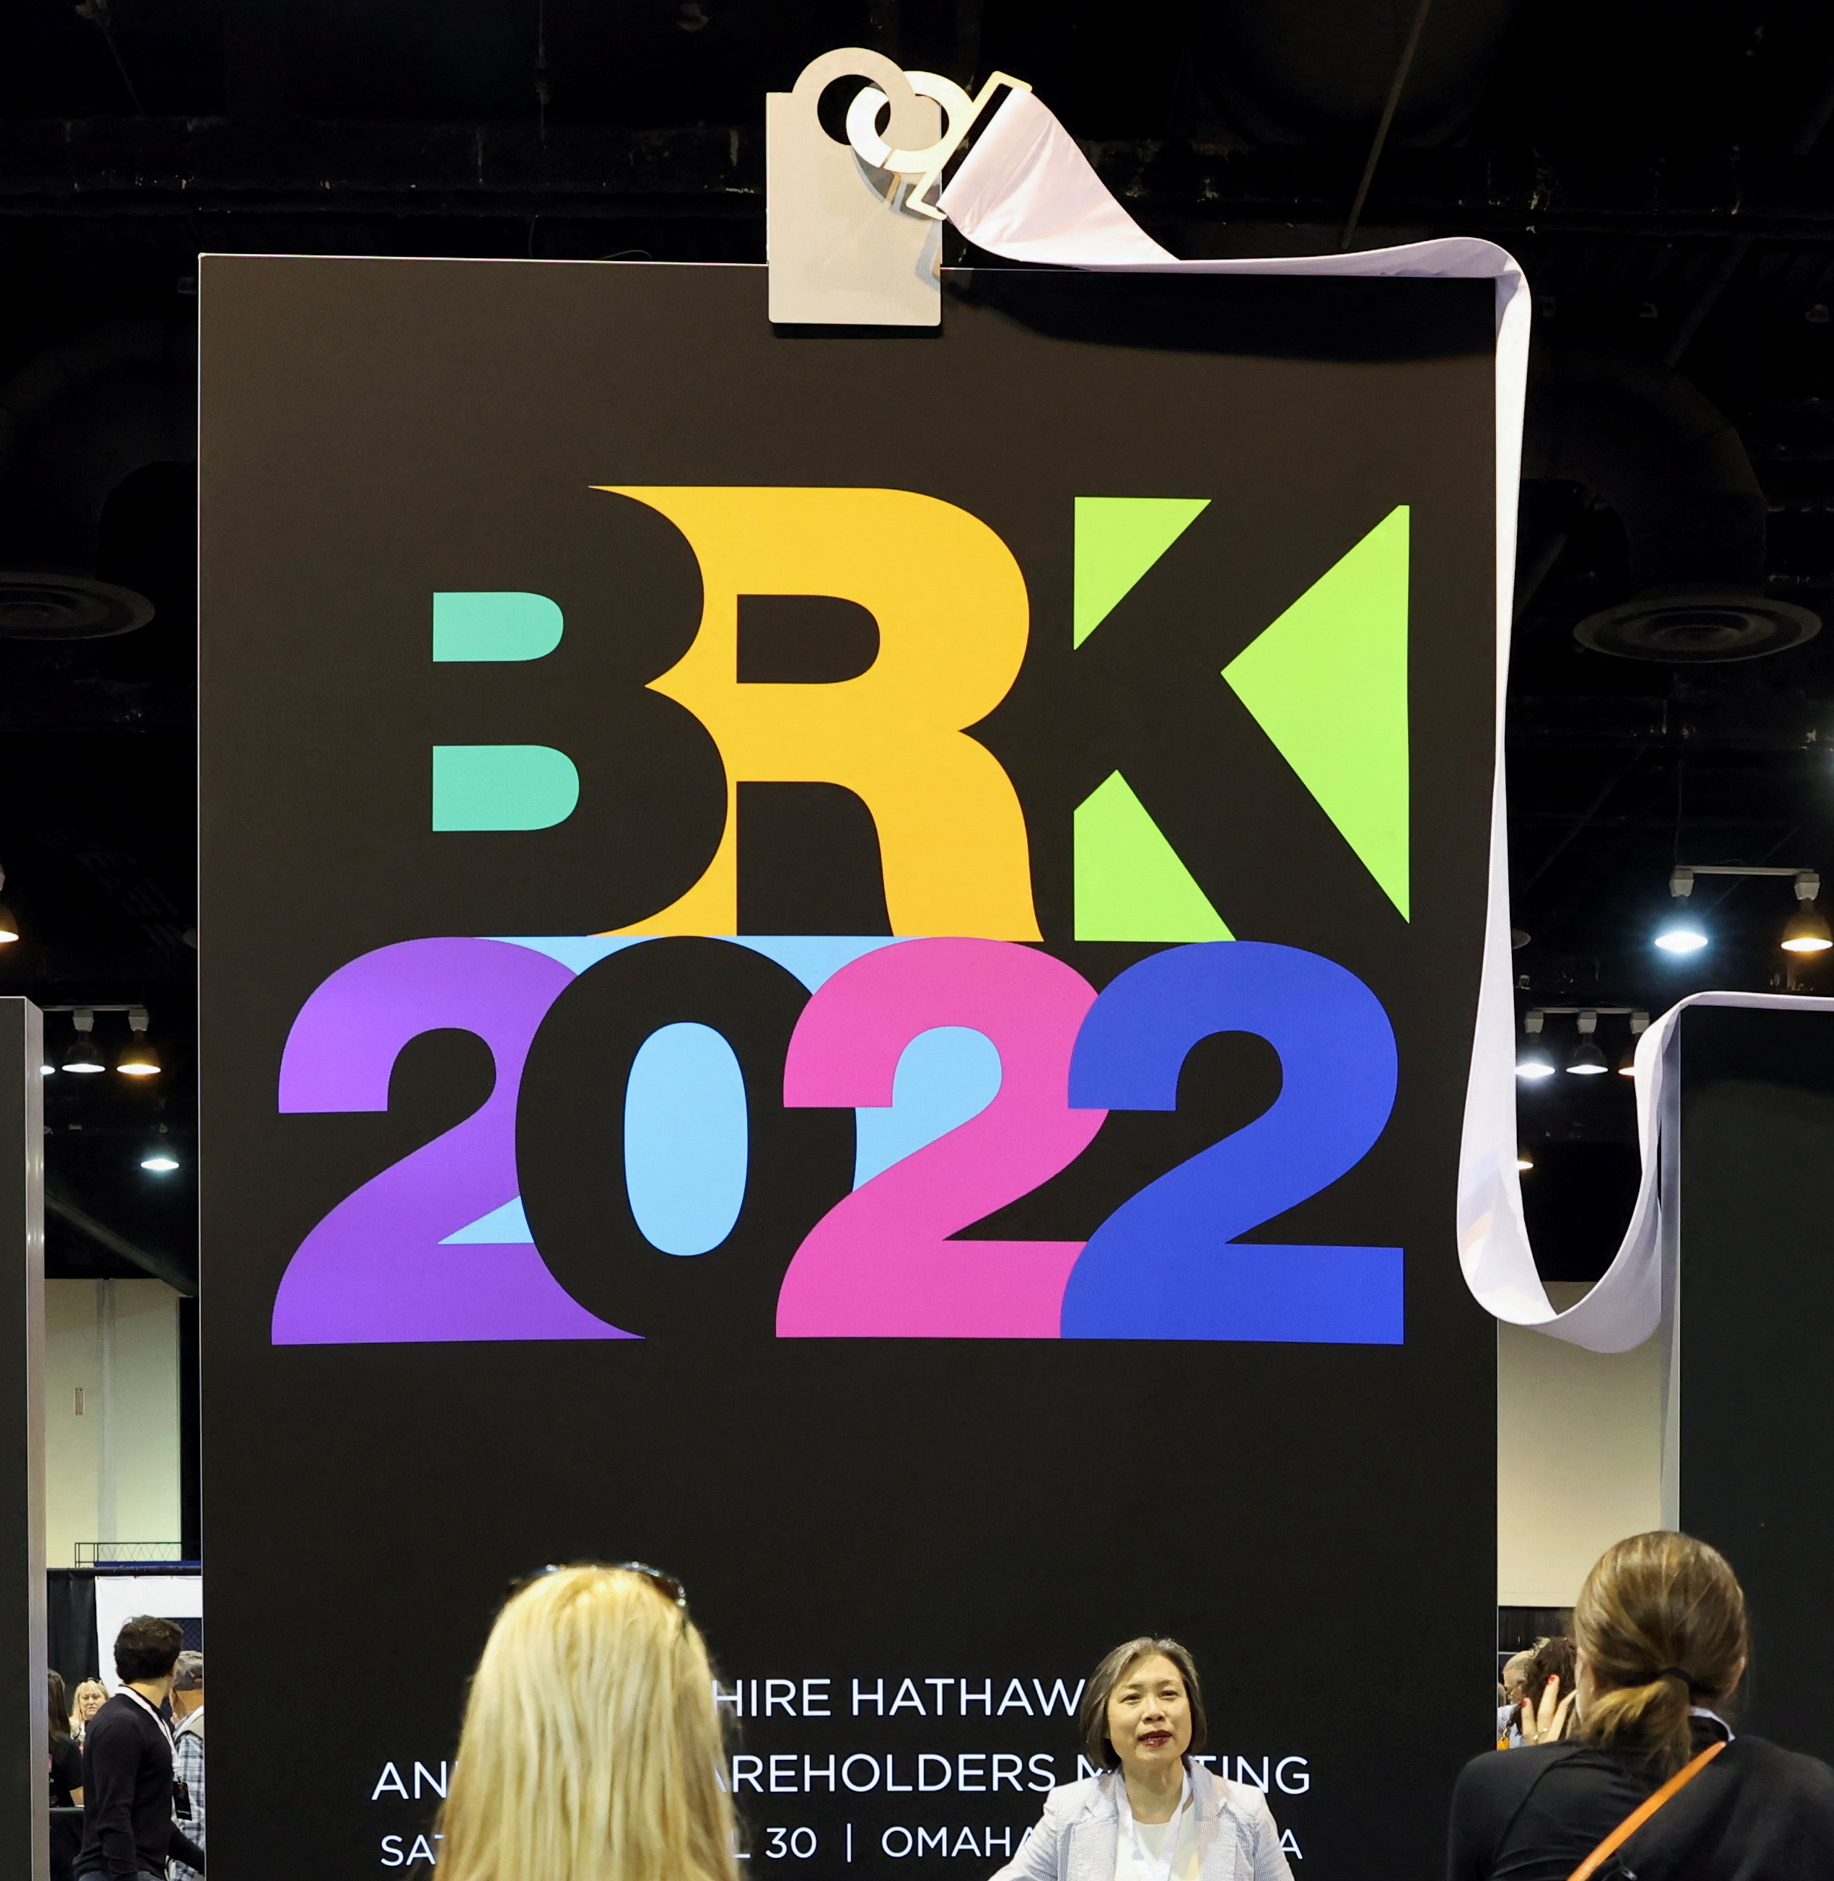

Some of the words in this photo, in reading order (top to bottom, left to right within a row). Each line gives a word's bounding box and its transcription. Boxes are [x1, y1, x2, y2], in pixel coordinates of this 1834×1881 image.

[431, 485, 1411, 943] BRK
[270, 935, 1406, 1346] 2022
[712, 1678, 832, 1717] HIRE
[851, 1677, 1086, 1717] HATHAW
[713, 1752, 1057, 1793] REHOLDERS
[765, 1826, 818, 1859] 30
